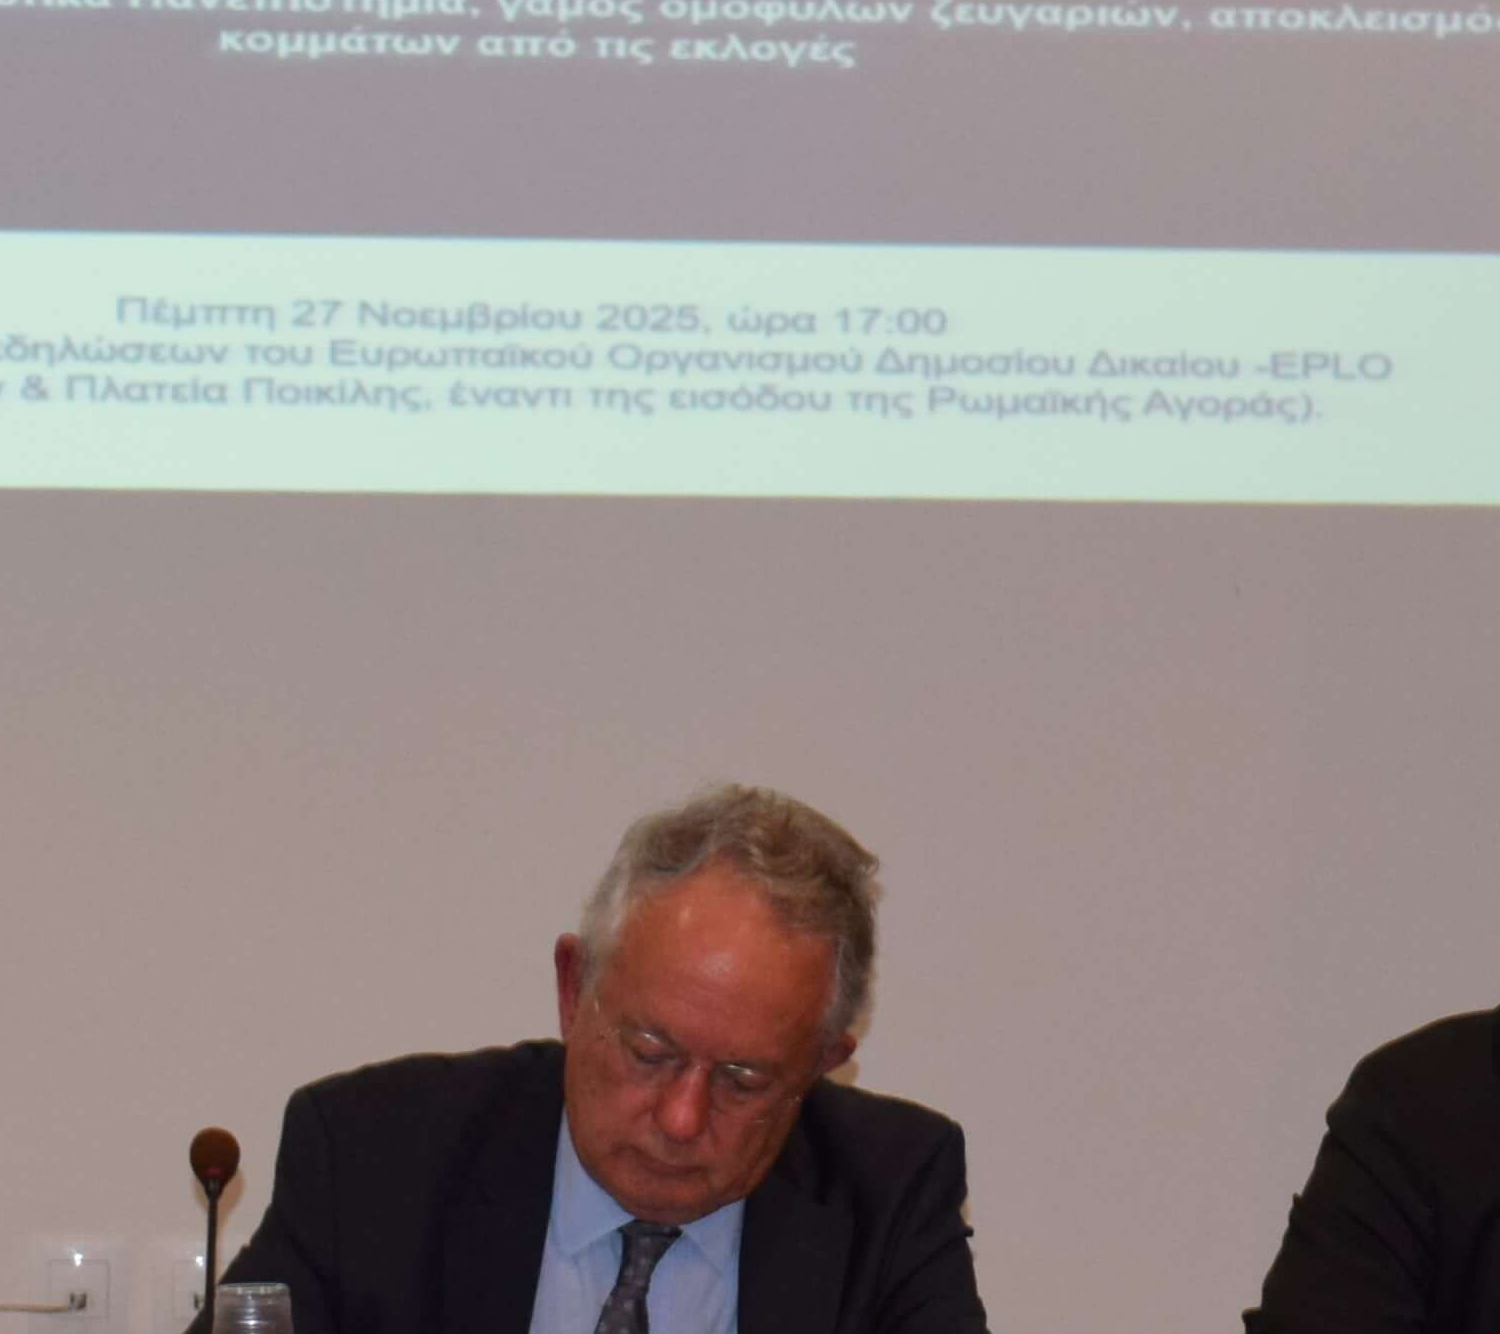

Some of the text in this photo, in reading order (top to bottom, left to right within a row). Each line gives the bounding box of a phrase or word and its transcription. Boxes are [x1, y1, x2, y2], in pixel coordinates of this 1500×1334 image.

[218, 26, 856, 69] κομμάτων από τις εκλογές
[115, 295, 949, 339] Πέμπτη 27 Νοεμβρίου 2025, ώρα 17:00
[244, 343, 314, 367] του
[328, 338, 595, 373] Ευρωπαϊκού
[605, 342, 865, 379] Οργανισμού
[873, 346, 1077, 381] Δημοσίου
[1086, 349, 1242, 380] Δικαίου
[20, 374, 50, 402] &
[64, 373, 229, 405] Πλατεία
[241, 376, 433, 414] Ποικίλης,
[447, 379, 573, 409] έναντι
[588, 386, 656, 417] της
[668, 382, 834, 413] εισόδου
[846, 390, 915, 420] της
[926, 385, 1133, 424] Ρωμαϊκής
